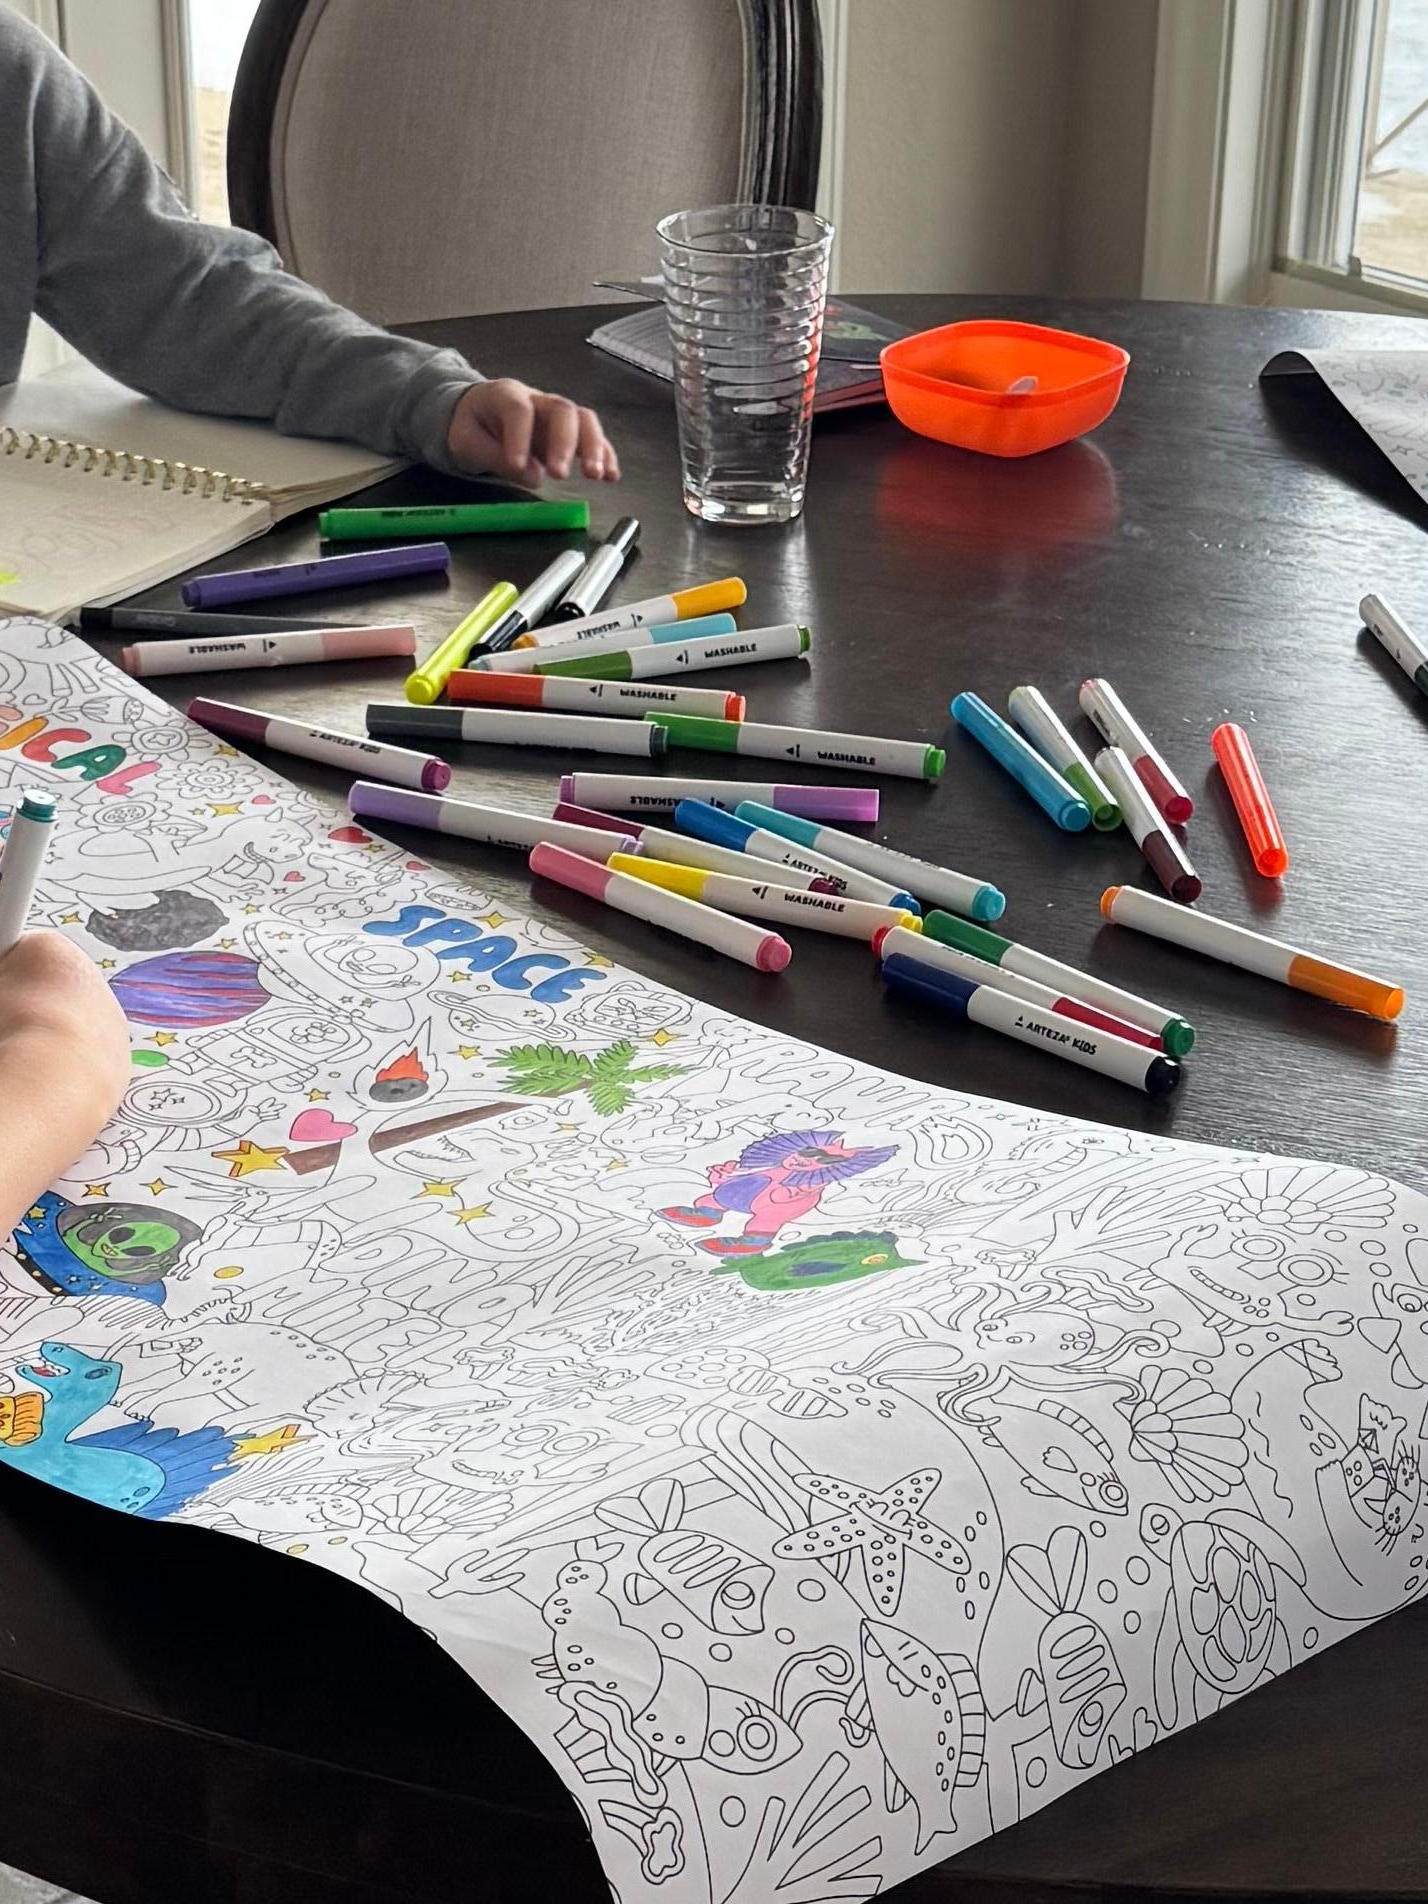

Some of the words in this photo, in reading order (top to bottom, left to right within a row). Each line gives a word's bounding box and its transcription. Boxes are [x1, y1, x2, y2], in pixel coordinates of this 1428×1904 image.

[188, 643, 247, 654] WASHABLE
[704, 643, 758, 659] WASHABLE
[619, 688, 677, 701] WASHABLE
[817, 751, 876, 766] WASHABLE
[784, 893, 845, 913] WASHABLE
[362, 905, 608, 1003] SPACE
[1072, 1038, 1098, 1055] KIDS
[718, 1043, 971, 1131] RAWR
[319, 1234, 537, 1328] DINO
